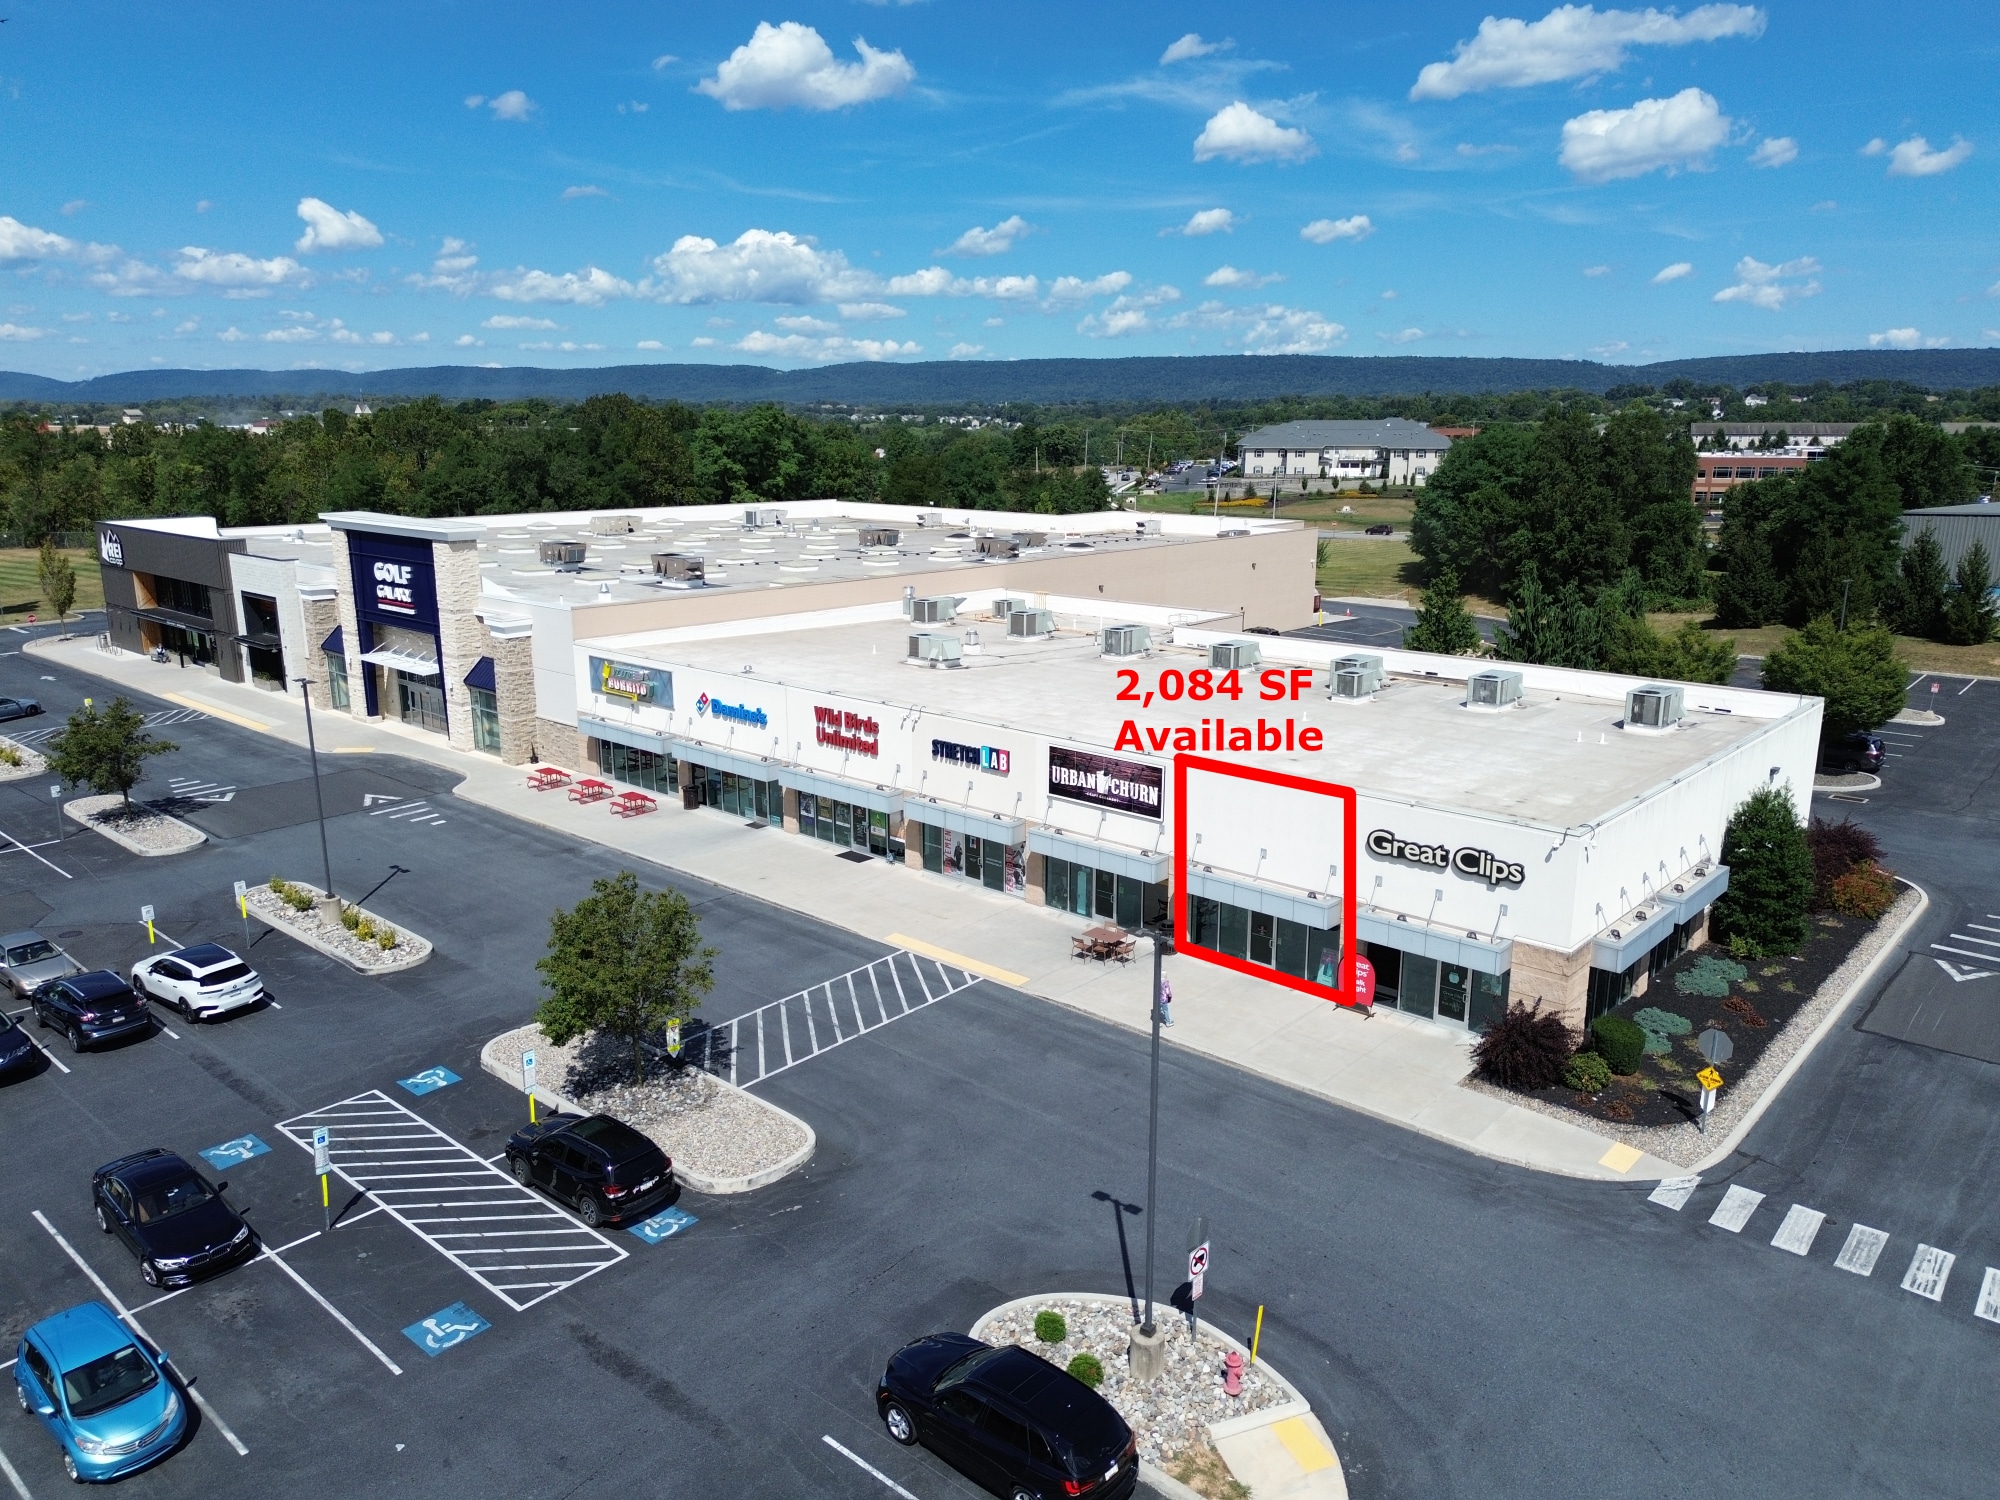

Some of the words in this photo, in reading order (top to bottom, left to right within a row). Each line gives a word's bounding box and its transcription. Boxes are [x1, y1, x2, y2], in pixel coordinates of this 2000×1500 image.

[108, 542, 123, 559] REI
[374, 562, 412, 585] GOLF
[376, 585, 413, 603] GALAXY
[608, 677, 647, 697] BURRITO
[711, 698, 768, 725] Domino's
[814, 706, 842, 727] Wild
[844, 712, 879, 735] Birds
[816, 726, 878, 755] Unlimited
[1051, 765, 1097, 789] URBAN
[1110, 778, 1159, 806] CHURN
[1368, 830, 1448, 867] Great
[1454, 847, 1524, 885] Clips
